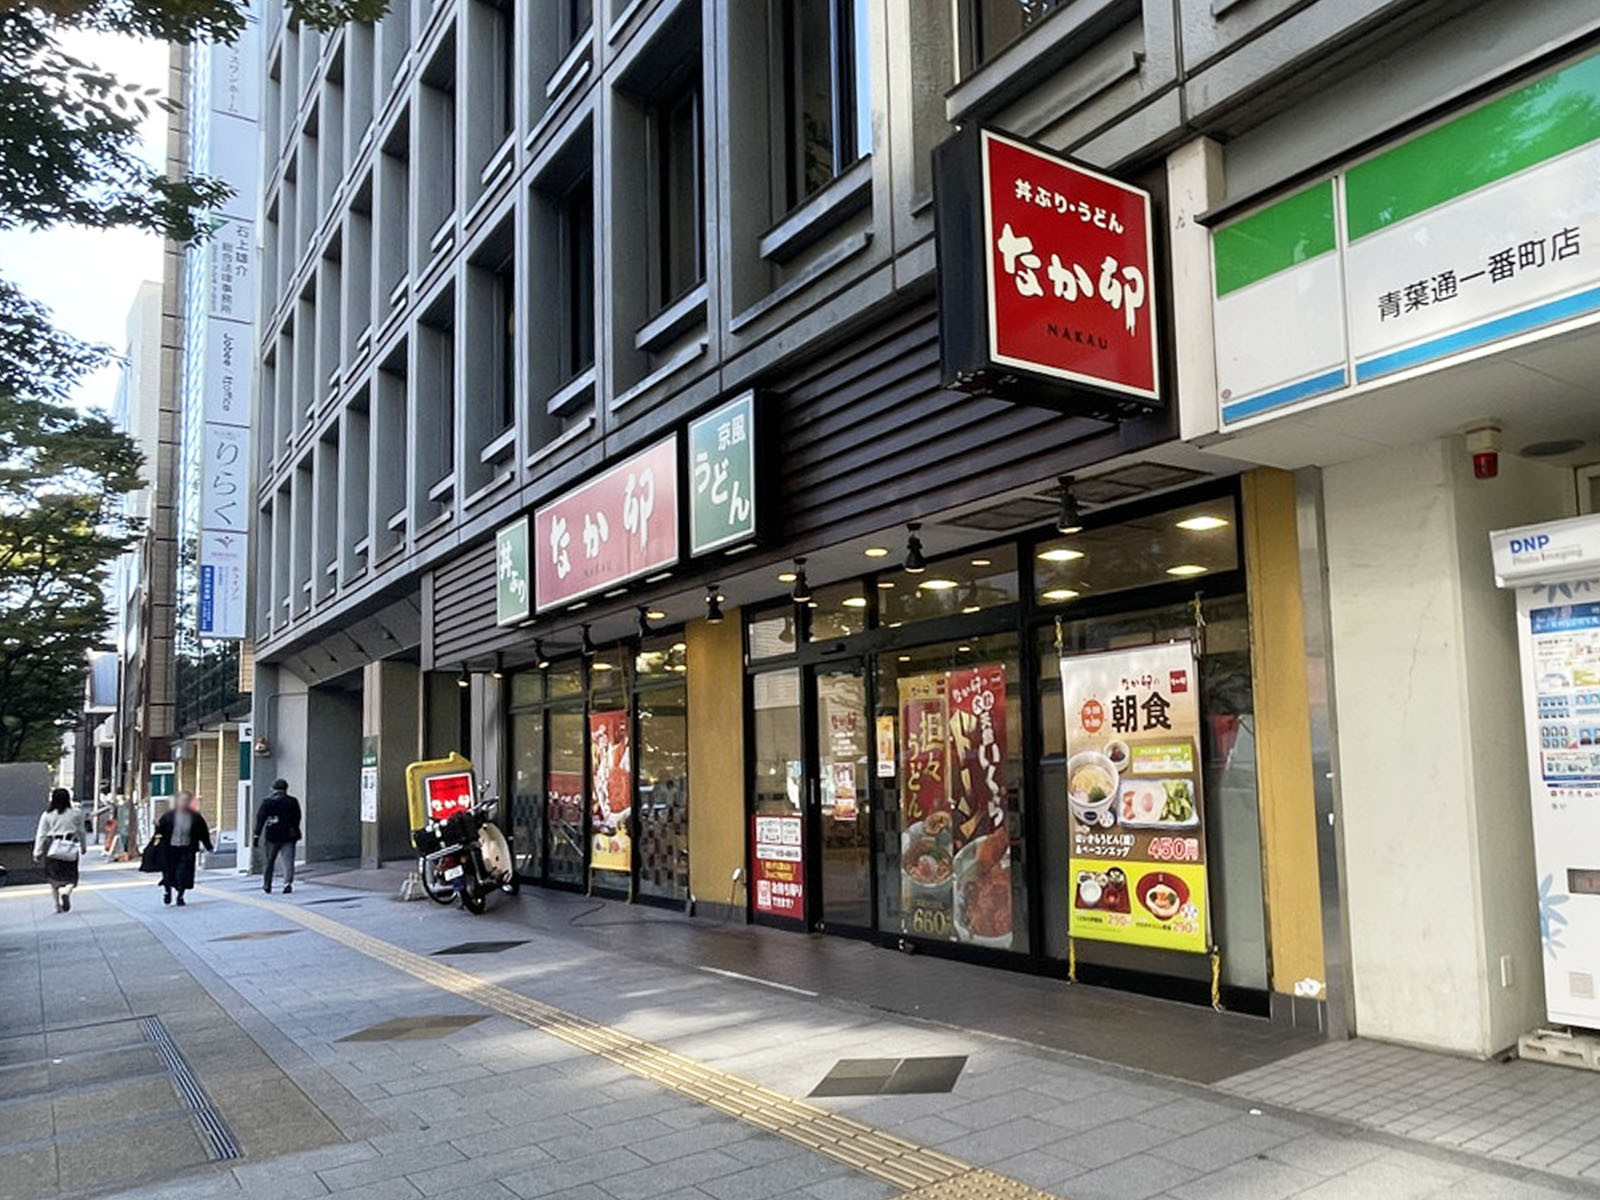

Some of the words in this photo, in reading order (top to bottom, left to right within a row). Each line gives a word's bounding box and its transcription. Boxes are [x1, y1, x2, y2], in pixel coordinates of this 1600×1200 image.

[997, 223, 1145, 337] なか卯
[1378, 226, 1581, 322] 青葉通一番町店
[1046, 323, 1109, 350] NAKAU
[717, 414, 746, 451] 京風
[213, 442, 238, 525] りらく
[695, 452, 750, 525] うどん
[550, 469, 655, 579] なか卯
[1510, 534, 1550, 554] DNP
[1111, 691, 1172, 734] 朝食
[907, 732, 923, 819] うどん
[1148, 837, 1199, 860] 450円
